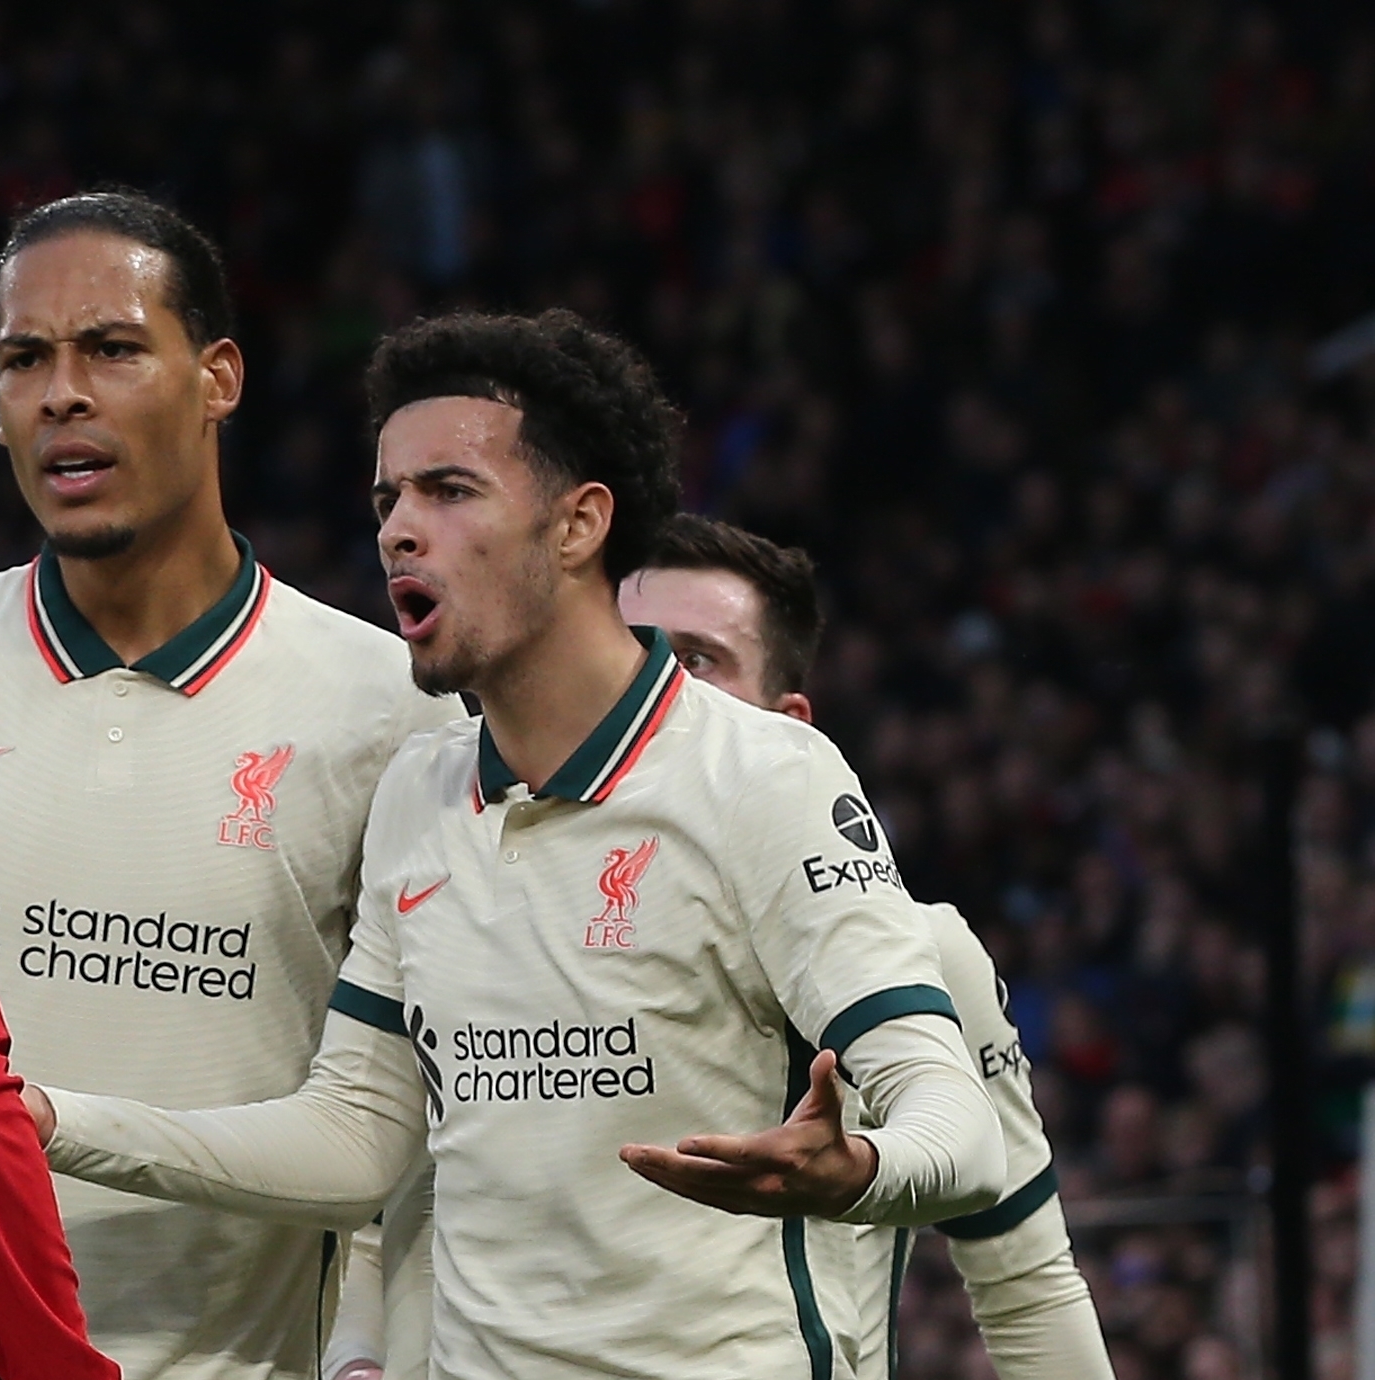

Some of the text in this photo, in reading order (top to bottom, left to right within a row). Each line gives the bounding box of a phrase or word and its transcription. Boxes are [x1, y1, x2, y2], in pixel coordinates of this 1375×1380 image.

[22, 899, 252, 959] standard
[20, 940, 257, 1001] chartered
[453, 1016, 638, 1061] standard
[454, 1055, 656, 1102] chartered
